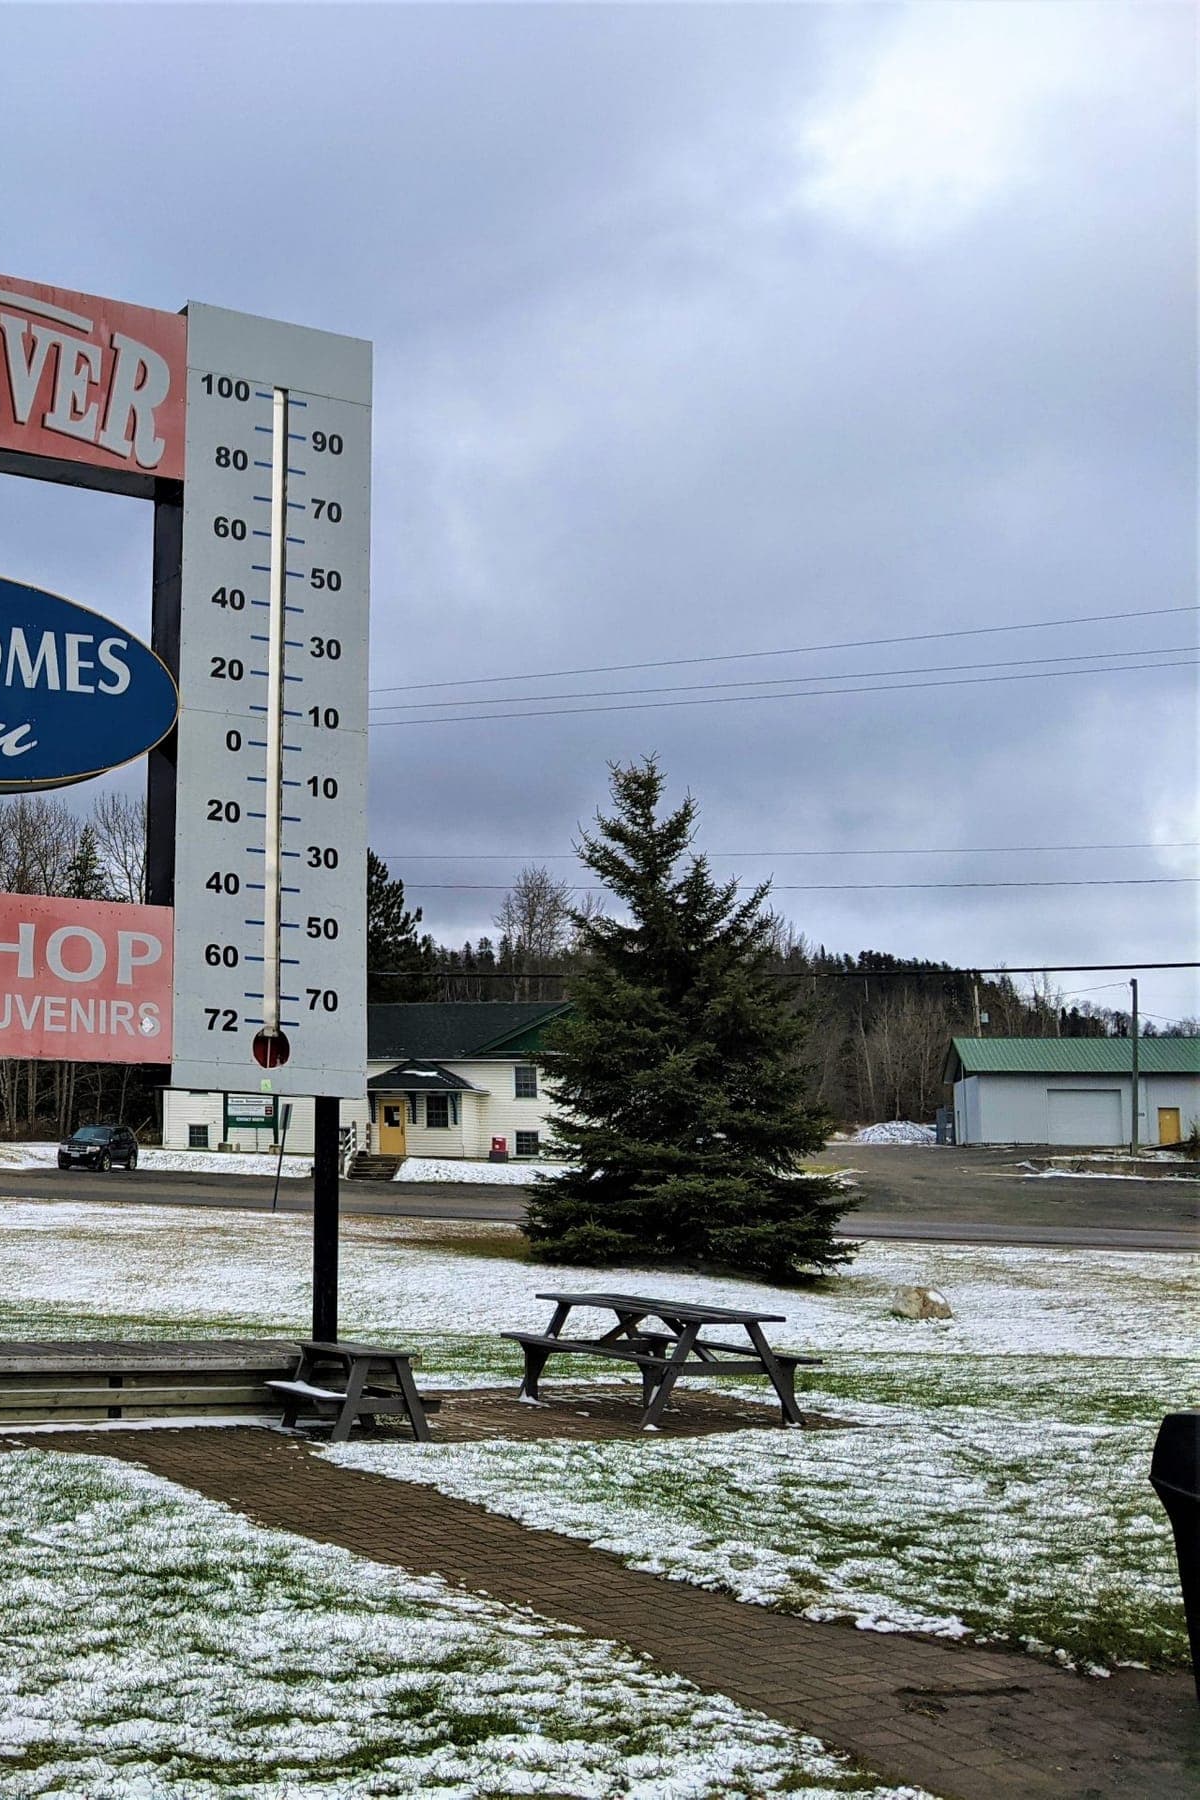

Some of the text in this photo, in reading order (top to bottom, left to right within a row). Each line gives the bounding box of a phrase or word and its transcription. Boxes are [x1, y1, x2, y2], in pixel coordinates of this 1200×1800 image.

[201, 373, 250, 402] 100
[311, 430, 344, 456] 90
[215, 446, 249, 471] 80
[311, 498, 342, 524] 70
[213, 516, 247, 541] 60
[310, 567, 342, 592] 50
[211, 586, 246, 611] 40
[310, 636, 342, 661] 30
[210, 656, 244, 681] 20
[308, 706, 340, 730] 10
[226, 729, 242, 752] 0
[307, 775, 338, 800] 10
[206, 799, 241, 824] 20
[307, 846, 339, 870] 30
[205, 871, 240, 896] 40
[306, 916, 339, 940] 50
[205, 943, 239, 968] 60
[306, 988, 338, 1012] 70
[204, 1007, 238, 1033] 72
